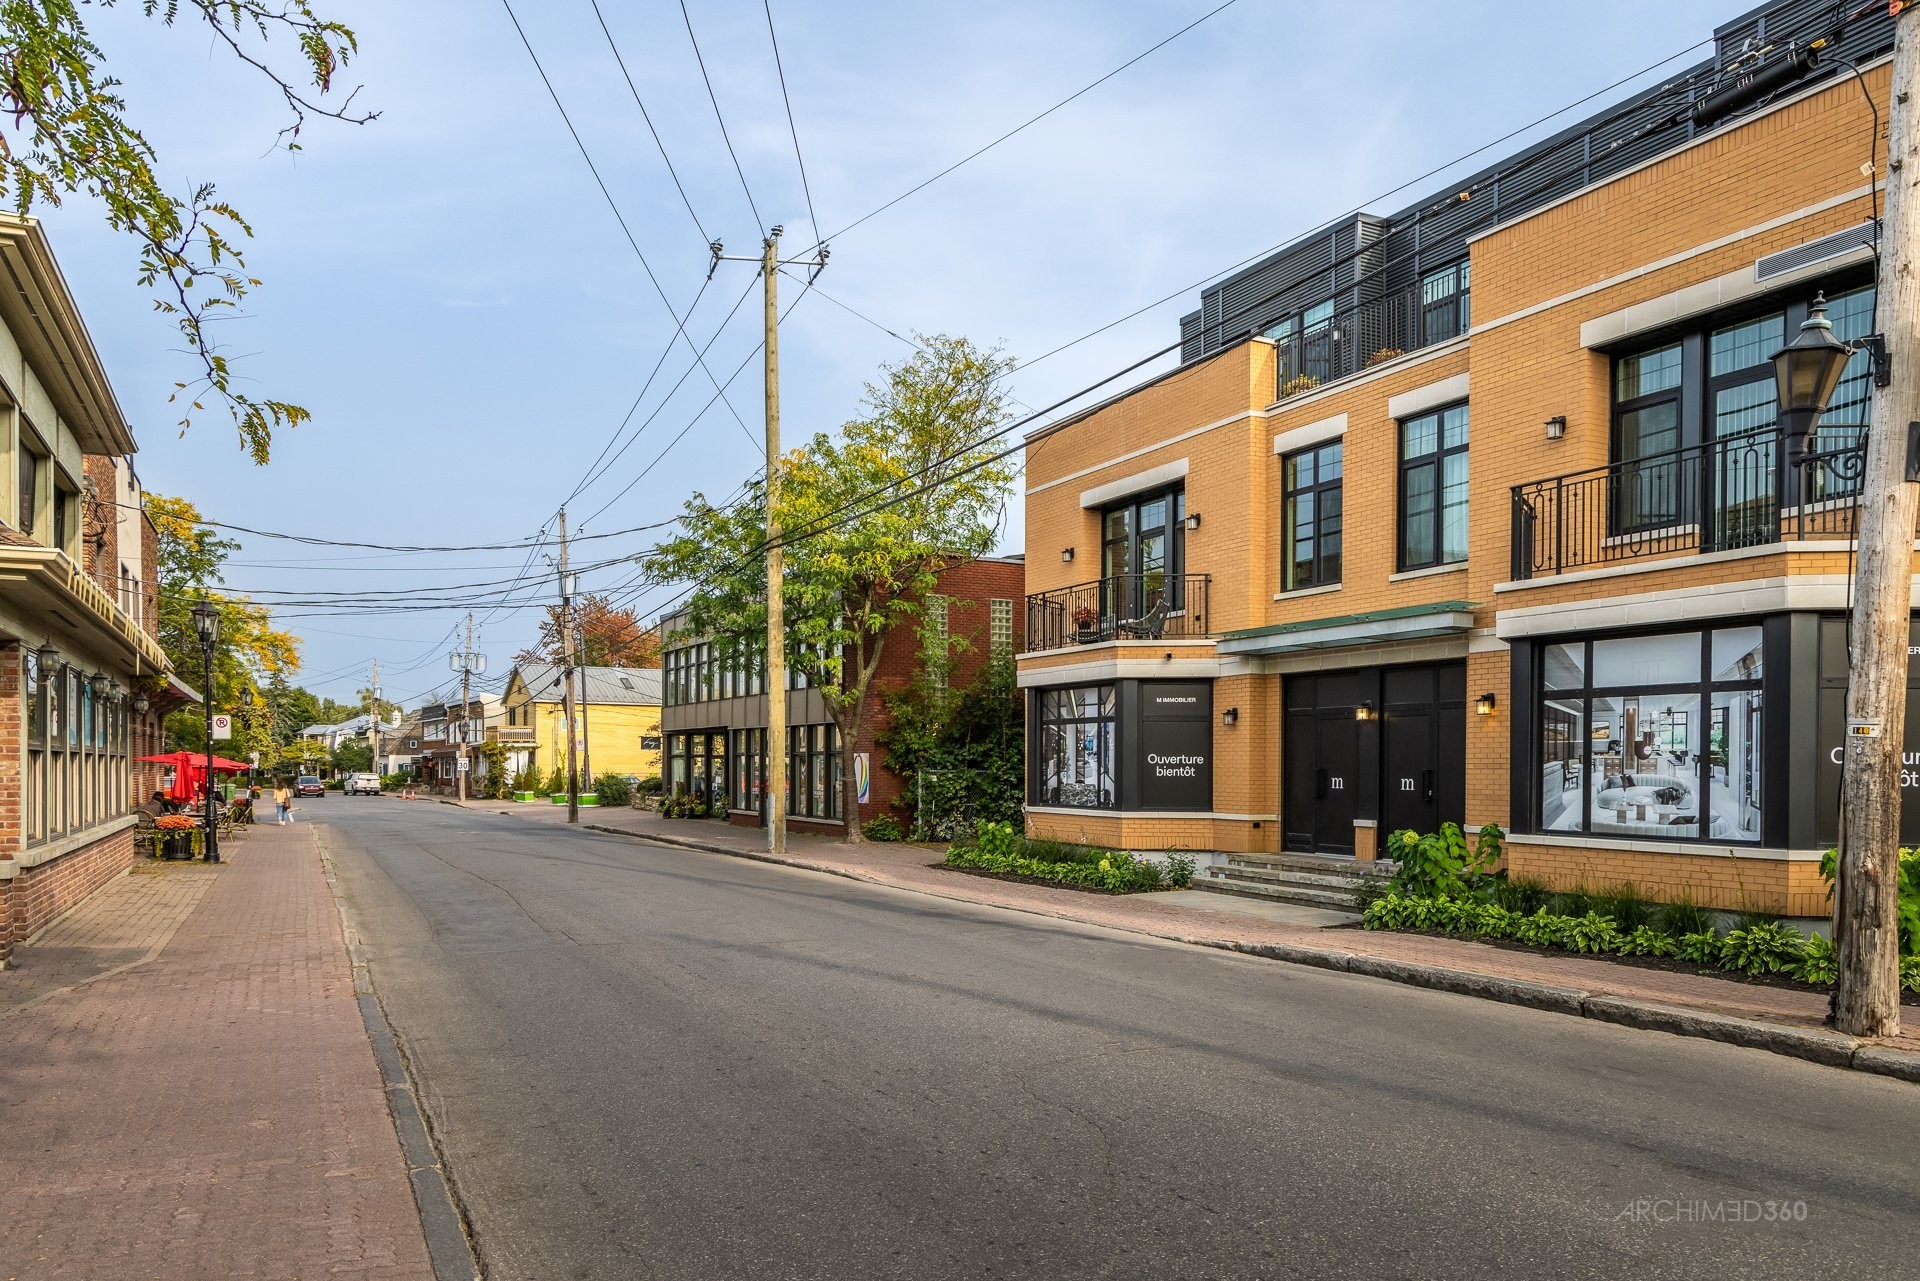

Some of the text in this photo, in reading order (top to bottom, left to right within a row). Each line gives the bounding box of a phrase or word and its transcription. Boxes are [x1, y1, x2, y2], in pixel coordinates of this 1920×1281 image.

[1147, 753, 1204, 764] Ouverture
[1156, 765, 1196, 777] bientôt
[1331, 777, 1344, 789] m
[1400, 778, 1415, 791] m
